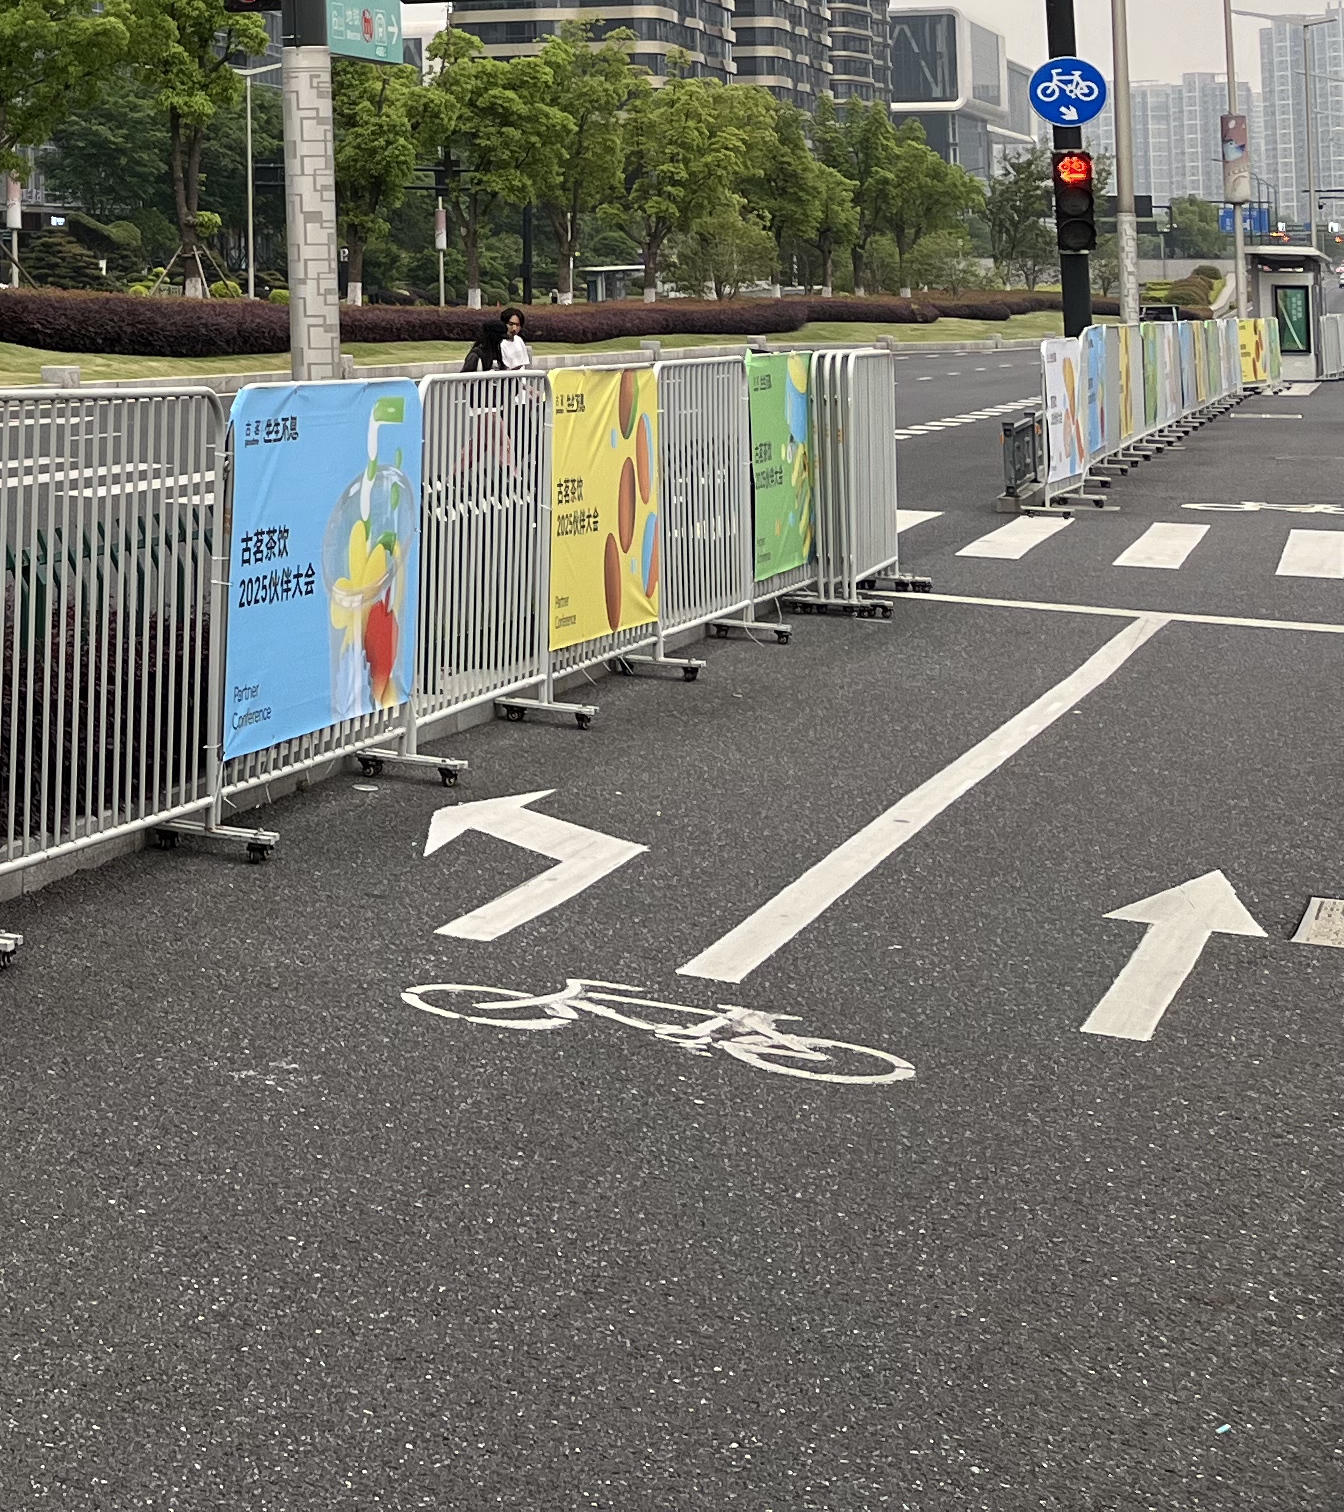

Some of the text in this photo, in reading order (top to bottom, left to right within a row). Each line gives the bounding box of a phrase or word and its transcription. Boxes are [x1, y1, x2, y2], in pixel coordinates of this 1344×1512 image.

[240, 524, 290, 568] 古茗茶饮
[238, 562, 316, 609] 2025伙伴大会
